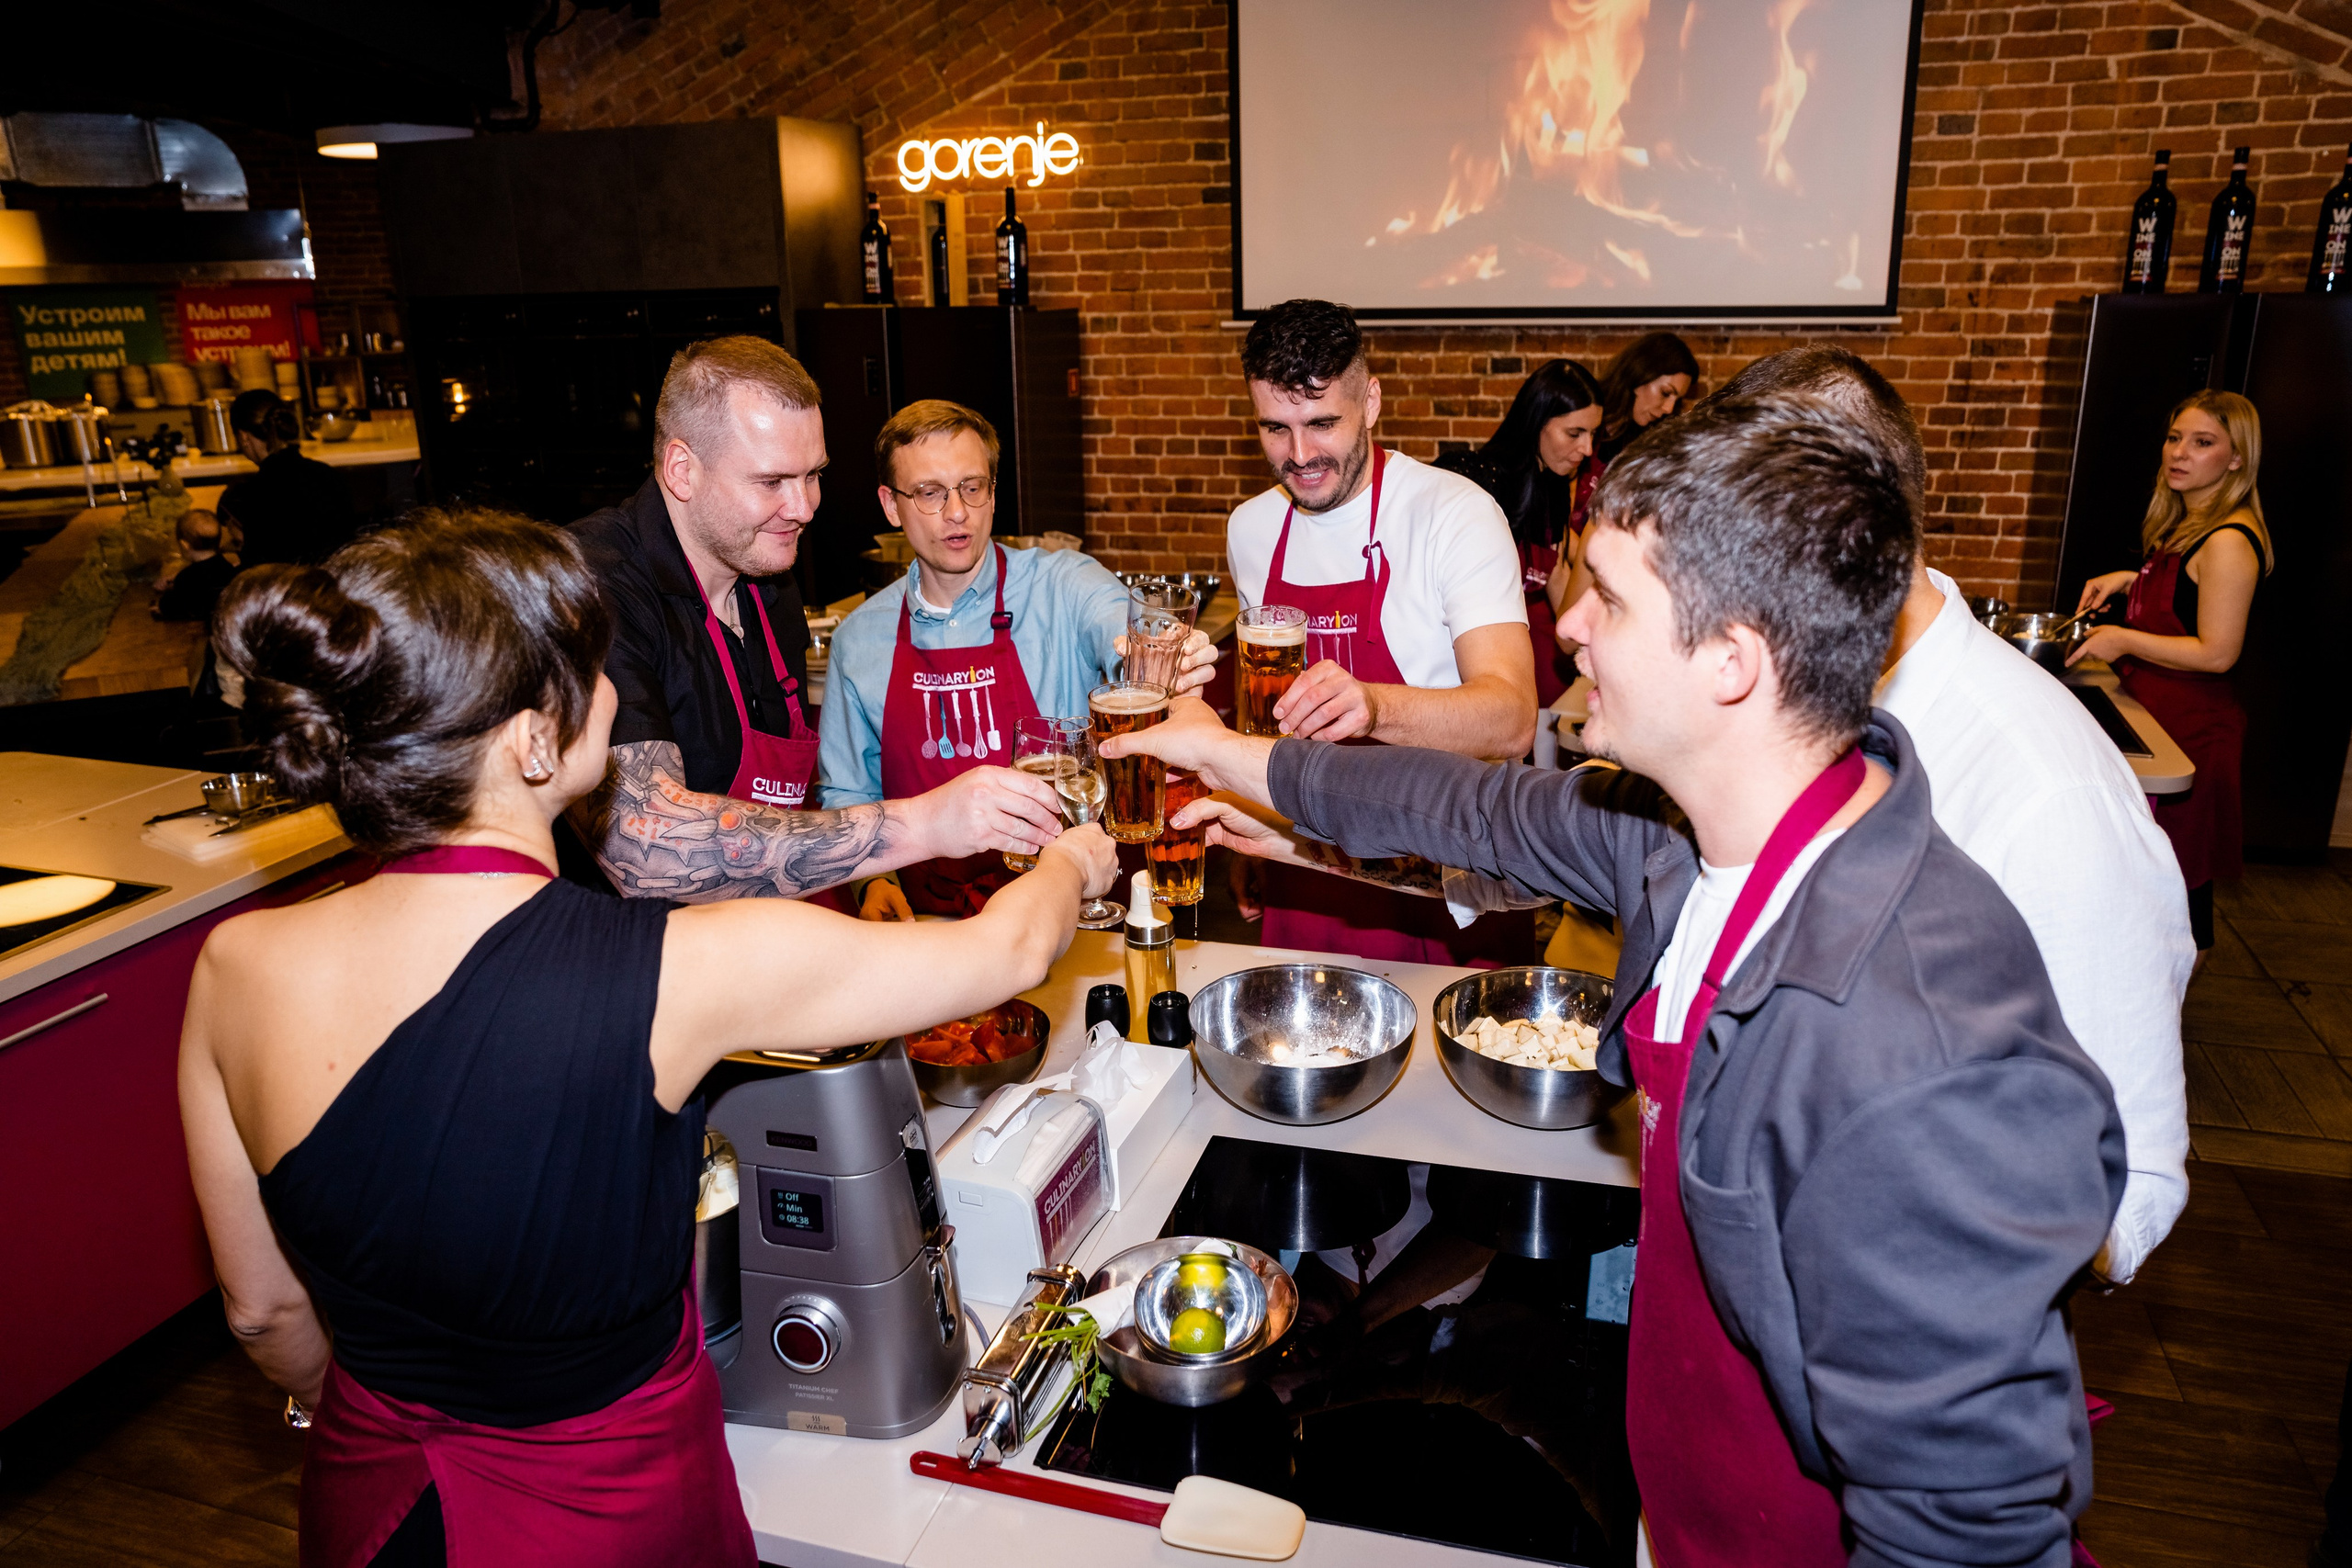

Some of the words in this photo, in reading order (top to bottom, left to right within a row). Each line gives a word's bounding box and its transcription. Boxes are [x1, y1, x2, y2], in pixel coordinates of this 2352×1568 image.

[898, 120, 1080, 192] gorenje
[18, 305, 146, 328] Устроим
[186, 302, 226, 321] Мы
[228, 304, 272, 320] вам
[25, 330, 125, 348] вашим
[189, 324, 251, 341] такое
[31, 347, 129, 375] детям!
[786, 1192, 799, 1201] Off
[786, 1203, 803, 1213] Min
[786, 1214, 809, 1224] 08:38
[788, 1383, 820, 1392] TITANIUM
[795, 1392, 825, 1400] PATISSIER
